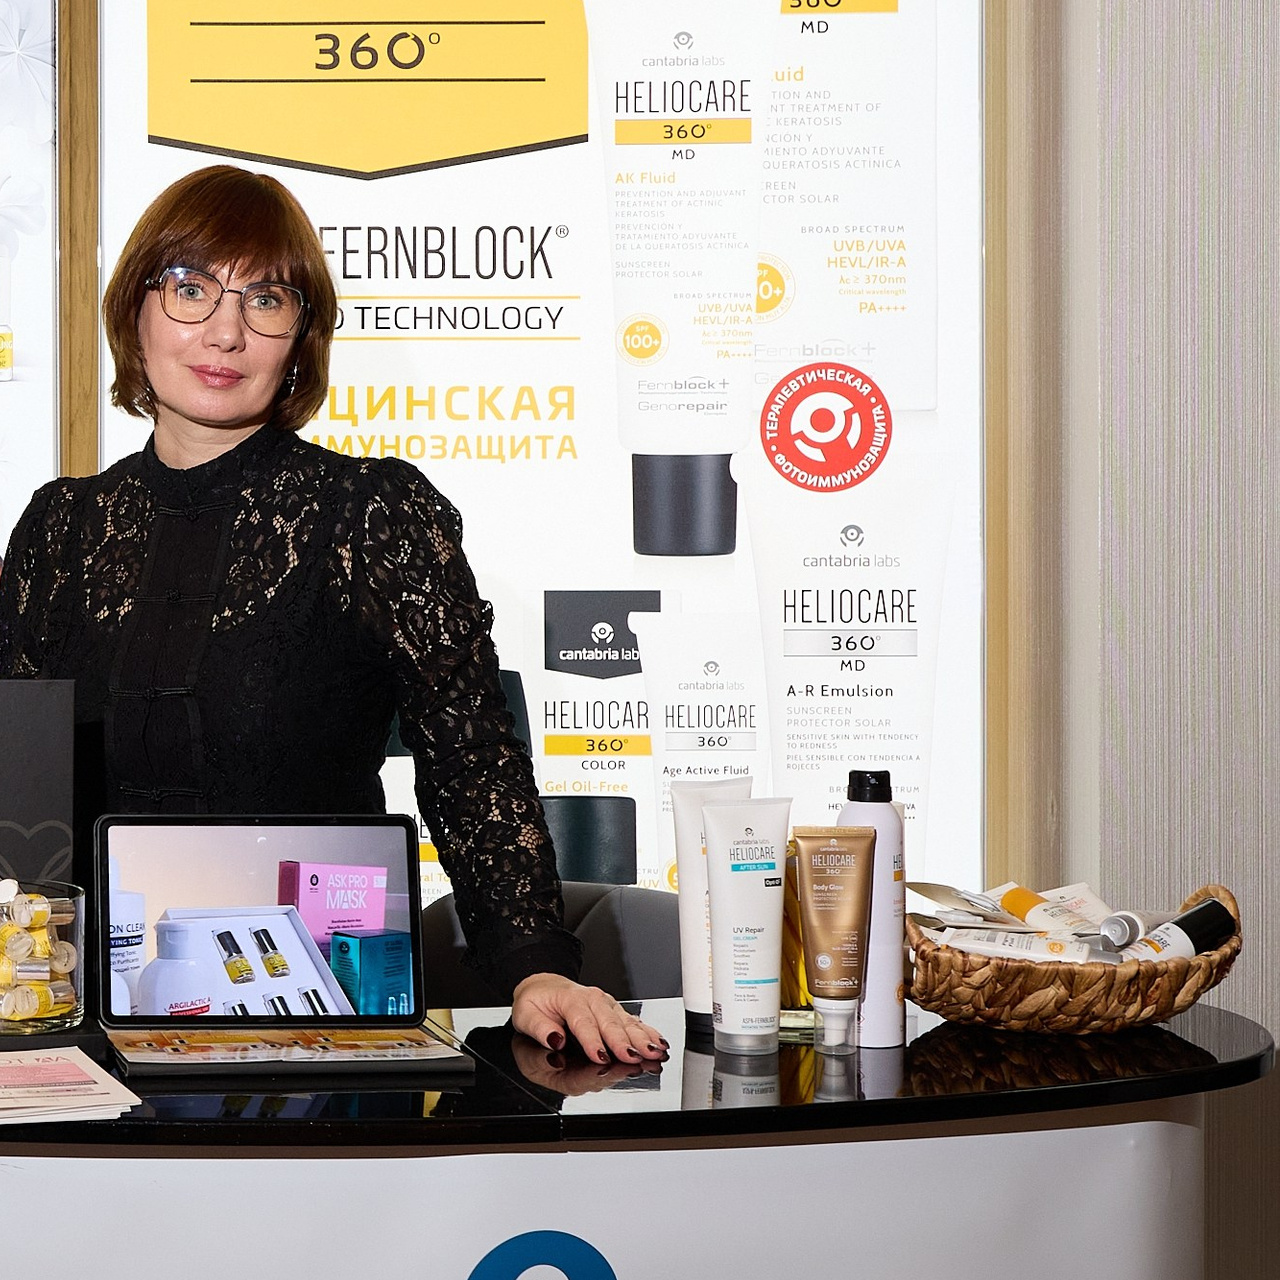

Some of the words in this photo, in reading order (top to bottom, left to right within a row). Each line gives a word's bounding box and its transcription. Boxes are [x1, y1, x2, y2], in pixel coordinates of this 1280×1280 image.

[801, 21, 829, 34] MD
[642, 56, 699, 67] cantabria
[702, 56, 725, 67] labs
[616, 80, 751, 113] HELIOCARE
[791, 103, 860, 112] TREATMENT
[777, 117, 842, 126] KERATOSIS
[671, 149, 695, 160] MD
[812, 146, 885, 155] ADYUVANTE
[615, 172, 635, 184] AK
[640, 172, 676, 184] Fluid
[834, 240, 906, 252] UVB/UVA
[828, 256, 906, 269] HEVL/IR-A
[354, 306, 564, 330] TECHNOLOGY
[625, 334, 660, 349] 100+
[766, 369, 873, 440] ТЕРАПЕВТИЧЕСКАЯ
[773, 404, 888, 488] ФОТОИММУНОЗАЩИТА
[803, 554, 870, 568] cantabria
[874, 554, 901, 568] labs
[784, 589, 917, 624] HELIOCARE
[559, 648, 619, 662] cantabria
[840, 660, 865, 672] MD
[678, 681, 724, 691] cantabria
[727, 681, 745, 691] labs
[787, 685, 815, 698] A-R
[821, 685, 894, 698] Emulsion
[665, 705, 756, 729] HELIOCARE
[787, 706, 852, 716] SUNSCREEN
[787, 718, 852, 728] PROTECTOR
[855, 718, 892, 728] SOLAR
[582, 760, 626, 770] COLOR
[663, 765, 681, 777] Age
[686, 765, 715, 775] Active
[719, 765, 749, 775] Fluid
[545, 780, 568, 793] Gel
[571, 780, 629, 793] Oil-Free
[730, 846, 775, 862] HELIOCARE
[812, 854, 855, 866] HELIOCARE
[328, 874, 348, 888] ASK
[348, 874, 368, 888] PRO
[326, 890, 367, 909] MASK
